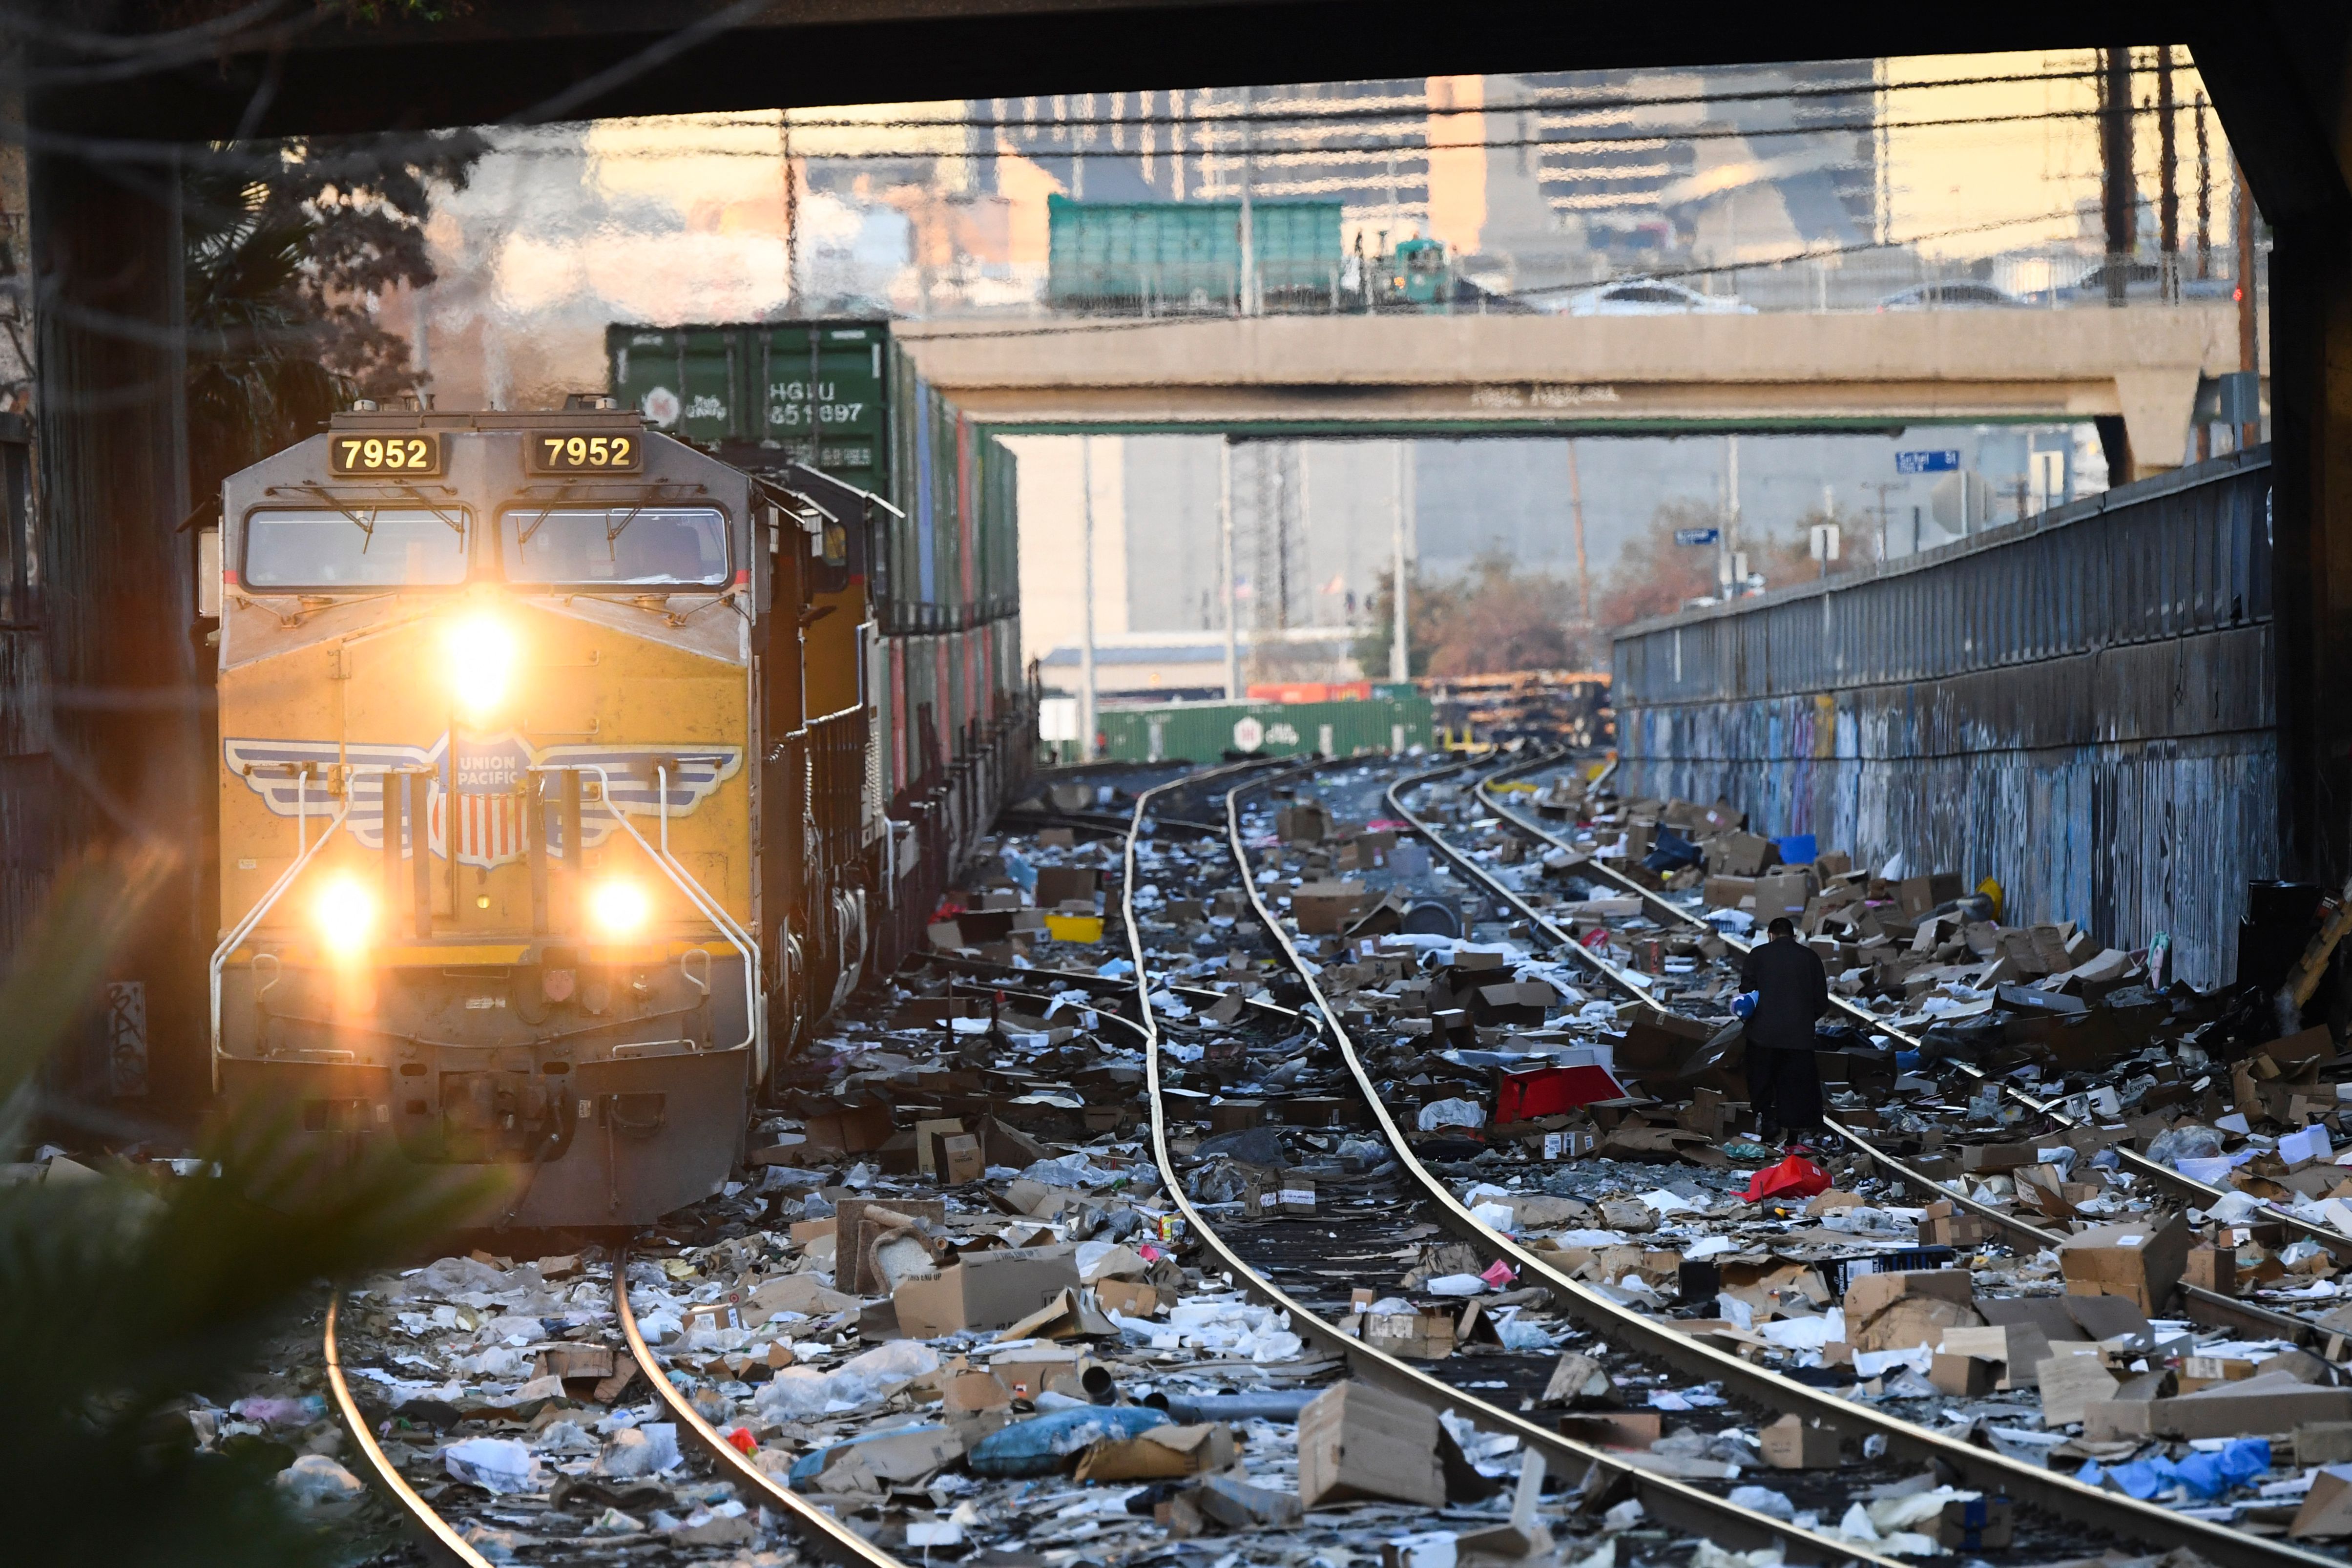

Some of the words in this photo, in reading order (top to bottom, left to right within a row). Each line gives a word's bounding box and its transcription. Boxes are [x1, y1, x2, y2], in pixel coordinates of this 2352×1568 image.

[342, 439, 427, 468] 7952
[544, 438, 630, 466] 7952
[459, 756, 516, 771] UNION
[458, 771, 518, 785] PACIFIC
[933, 1273, 942, 1281] UP
[1837, 1264, 1846, 1296] SPALDING
